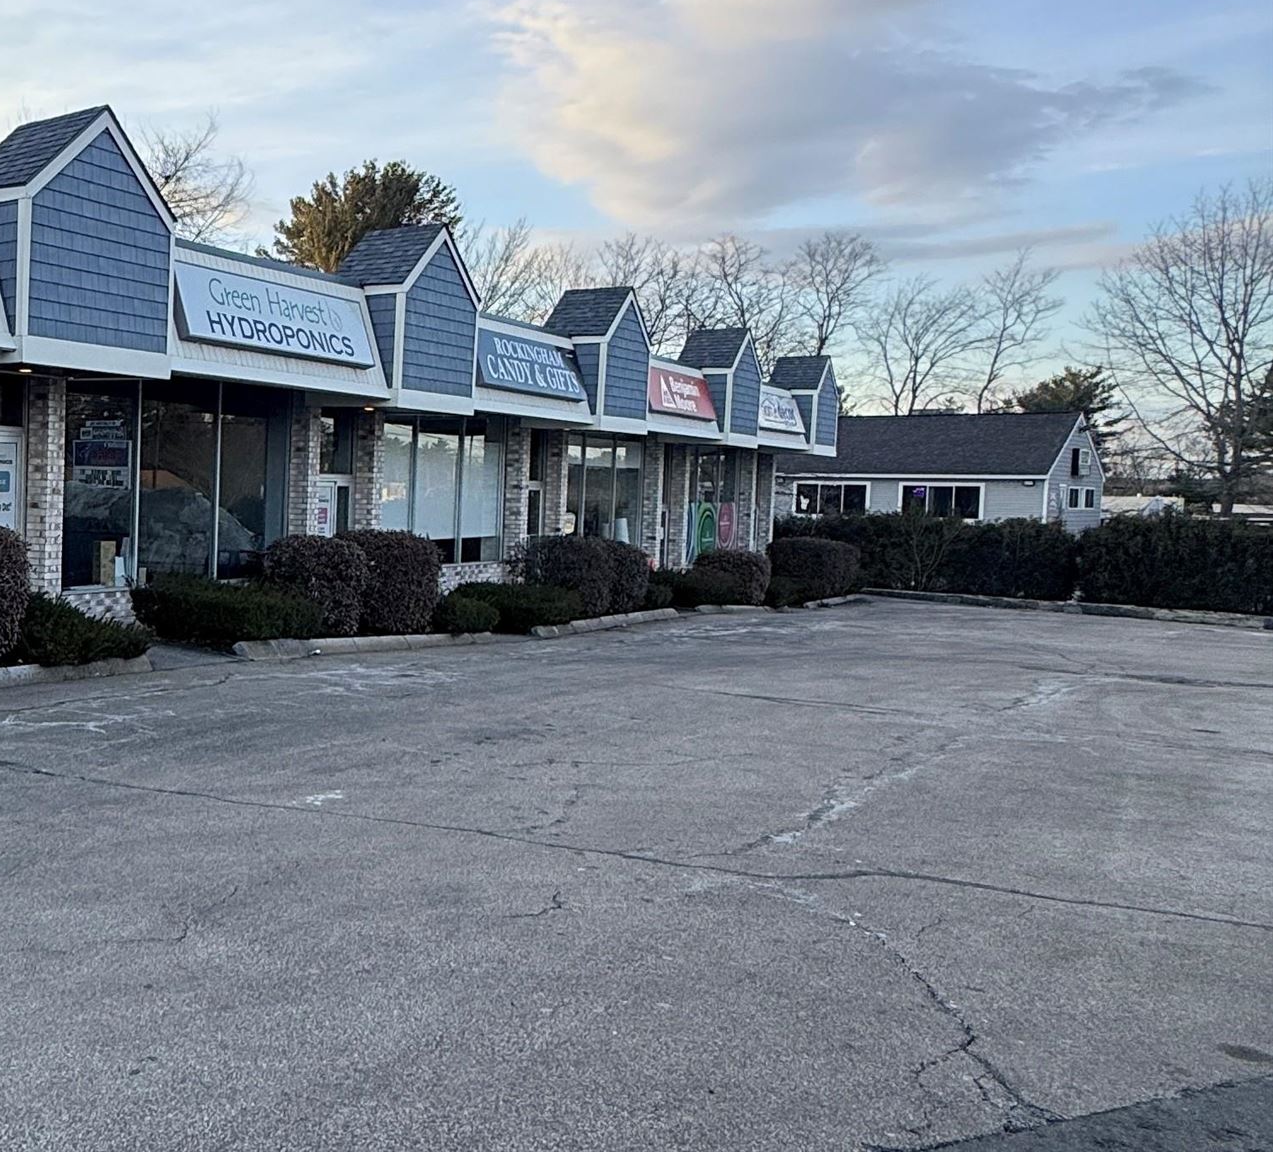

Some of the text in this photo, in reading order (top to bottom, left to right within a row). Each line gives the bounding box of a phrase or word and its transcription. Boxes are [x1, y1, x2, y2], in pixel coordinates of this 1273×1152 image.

[208, 278, 327, 326] Green Harvest
[206, 310, 355, 357] HYDROPONICS
[493, 337, 564, 368] ROCKINGHAM
[487, 354, 580, 393] CANDY & GIFTS
